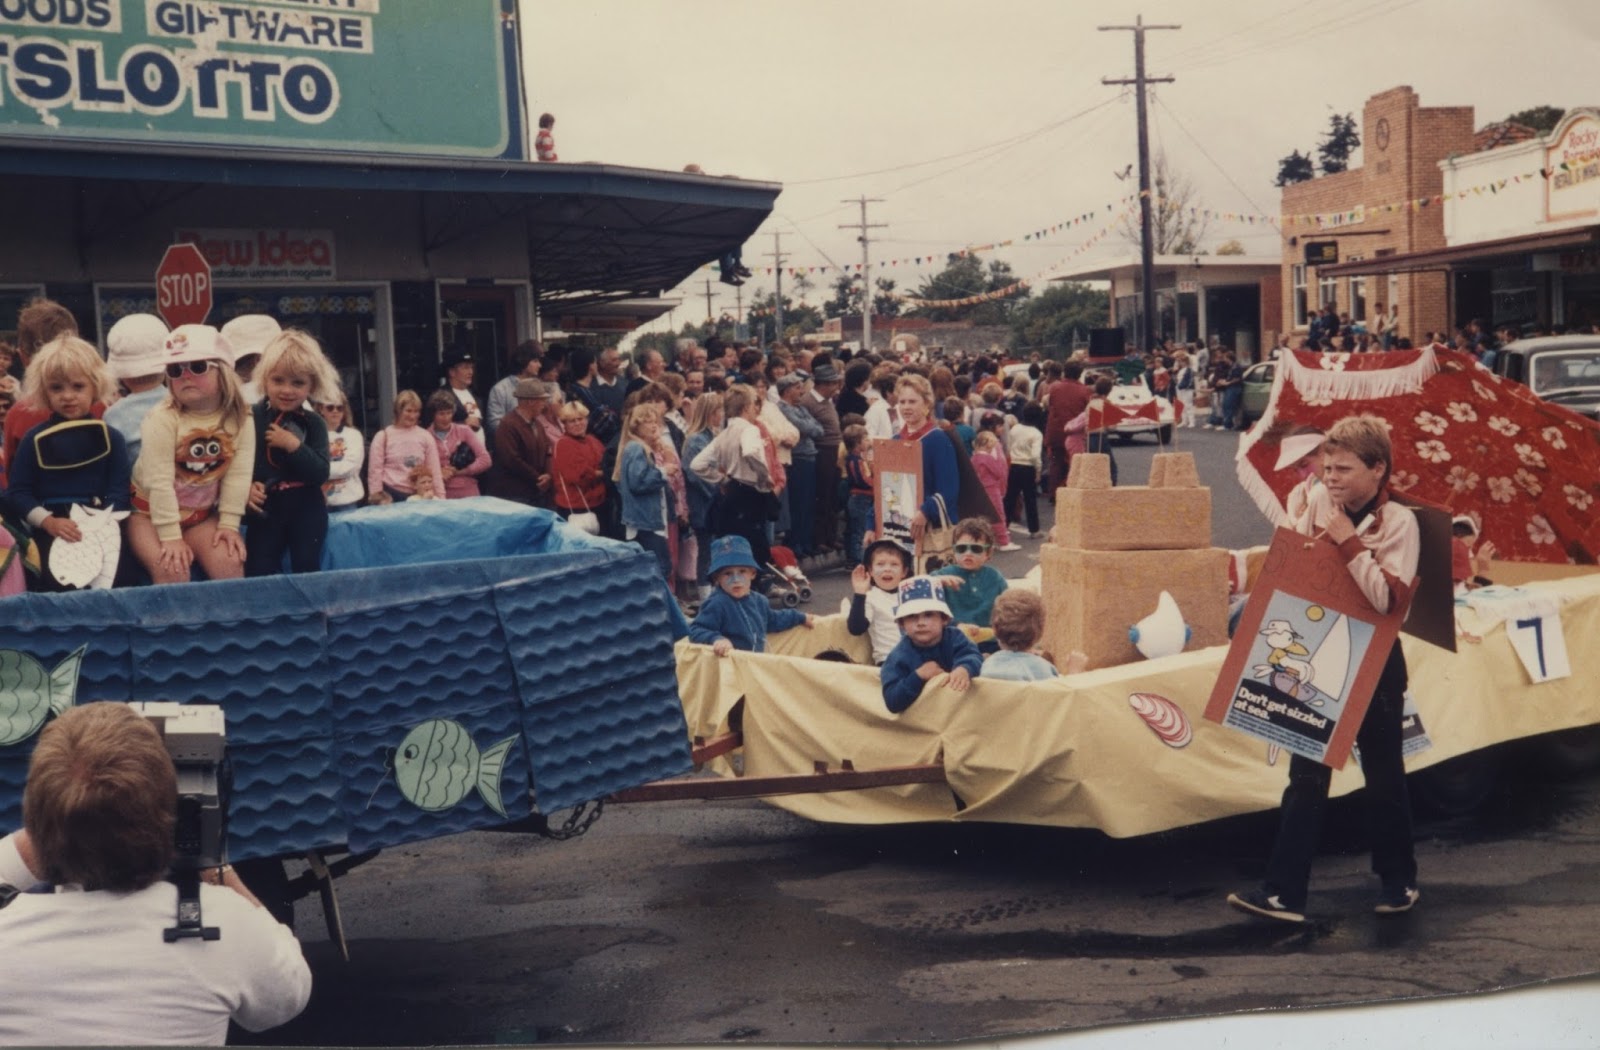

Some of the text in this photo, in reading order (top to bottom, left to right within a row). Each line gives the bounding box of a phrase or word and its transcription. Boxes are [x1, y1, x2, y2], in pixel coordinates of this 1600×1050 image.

[156, 2, 364, 49] GIFTWARE
[257, 230, 332, 267] Idea
[160, 272, 207, 308] STOP
[1516, 617, 1547, 678] 7
[1233, 700, 1270, 720] at sea.
[1238, 686, 1327, 729] Don't get sizzled
